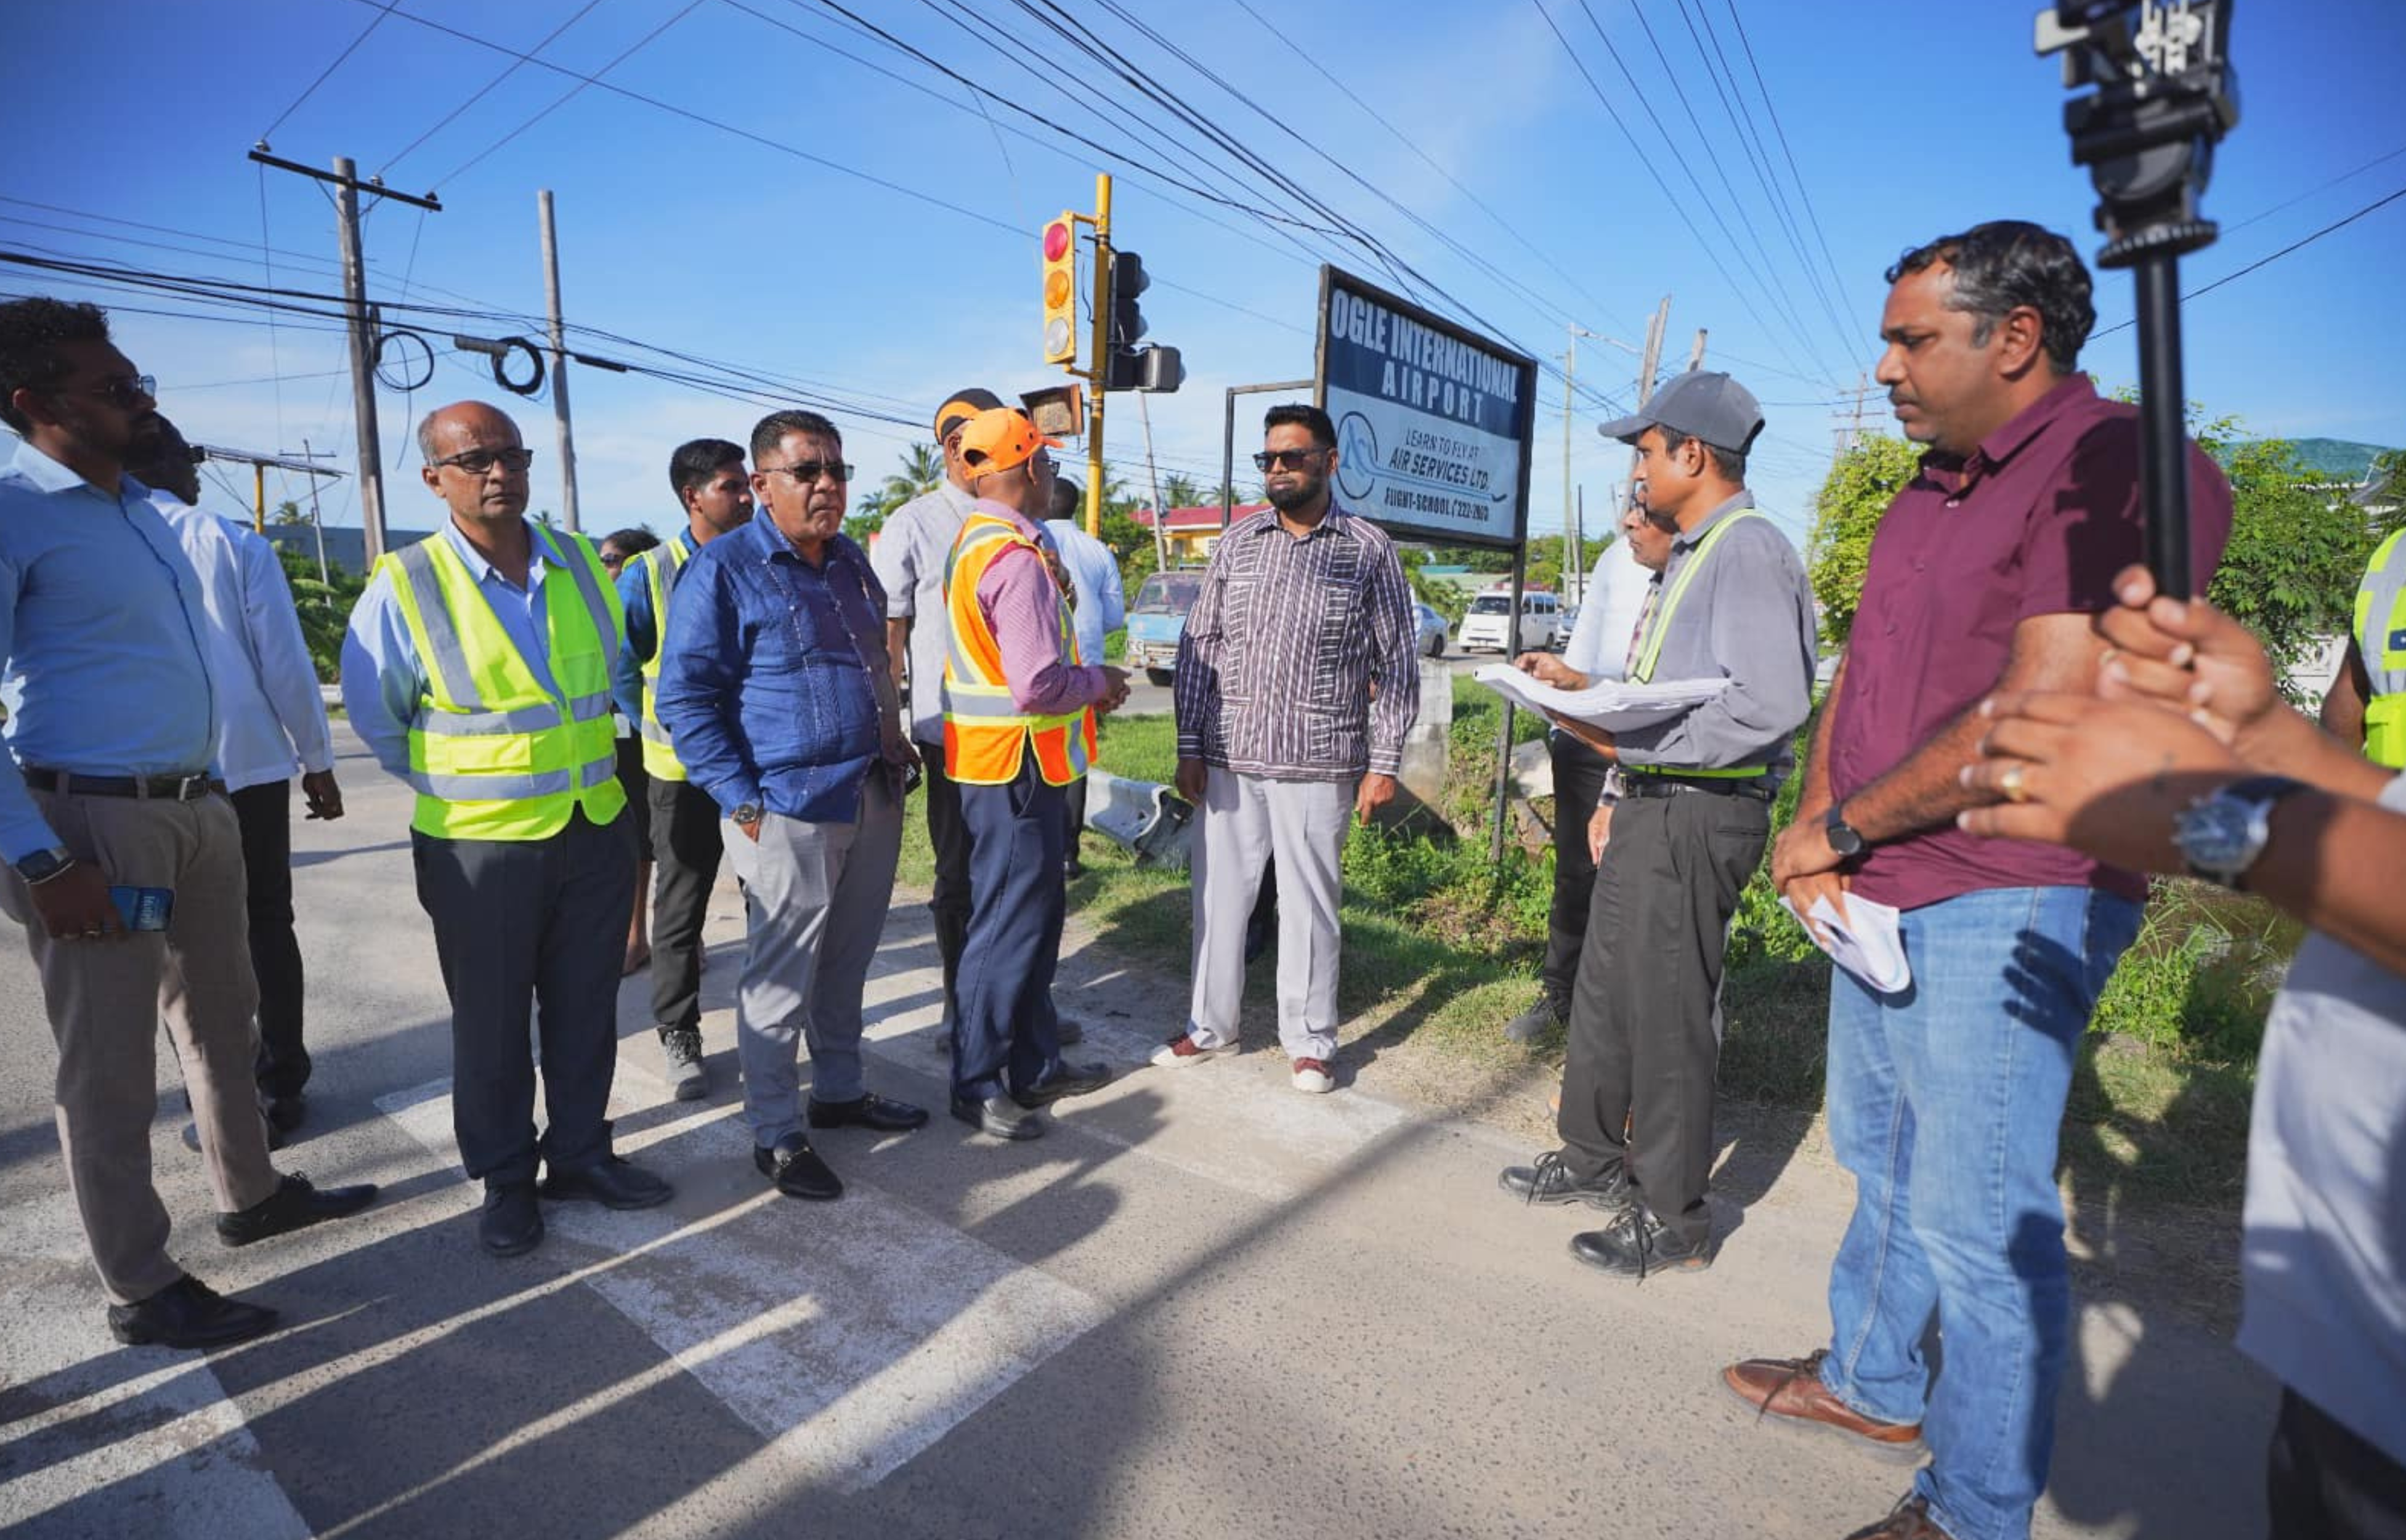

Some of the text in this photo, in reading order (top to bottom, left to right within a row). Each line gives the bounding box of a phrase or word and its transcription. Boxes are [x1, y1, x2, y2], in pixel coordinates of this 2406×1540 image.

[1331, 288, 1518, 403] OGLE INTERNATIONAL
[1382, 360, 1483, 423] AIRPORT
[1389, 447, 1411, 471] AIR
[1411, 453, 1469, 484] SERVICES
[1406, 426, 1438, 452] LEARN
[1439, 437, 1451, 455] TO
[1452, 440, 1468, 458] FLY
